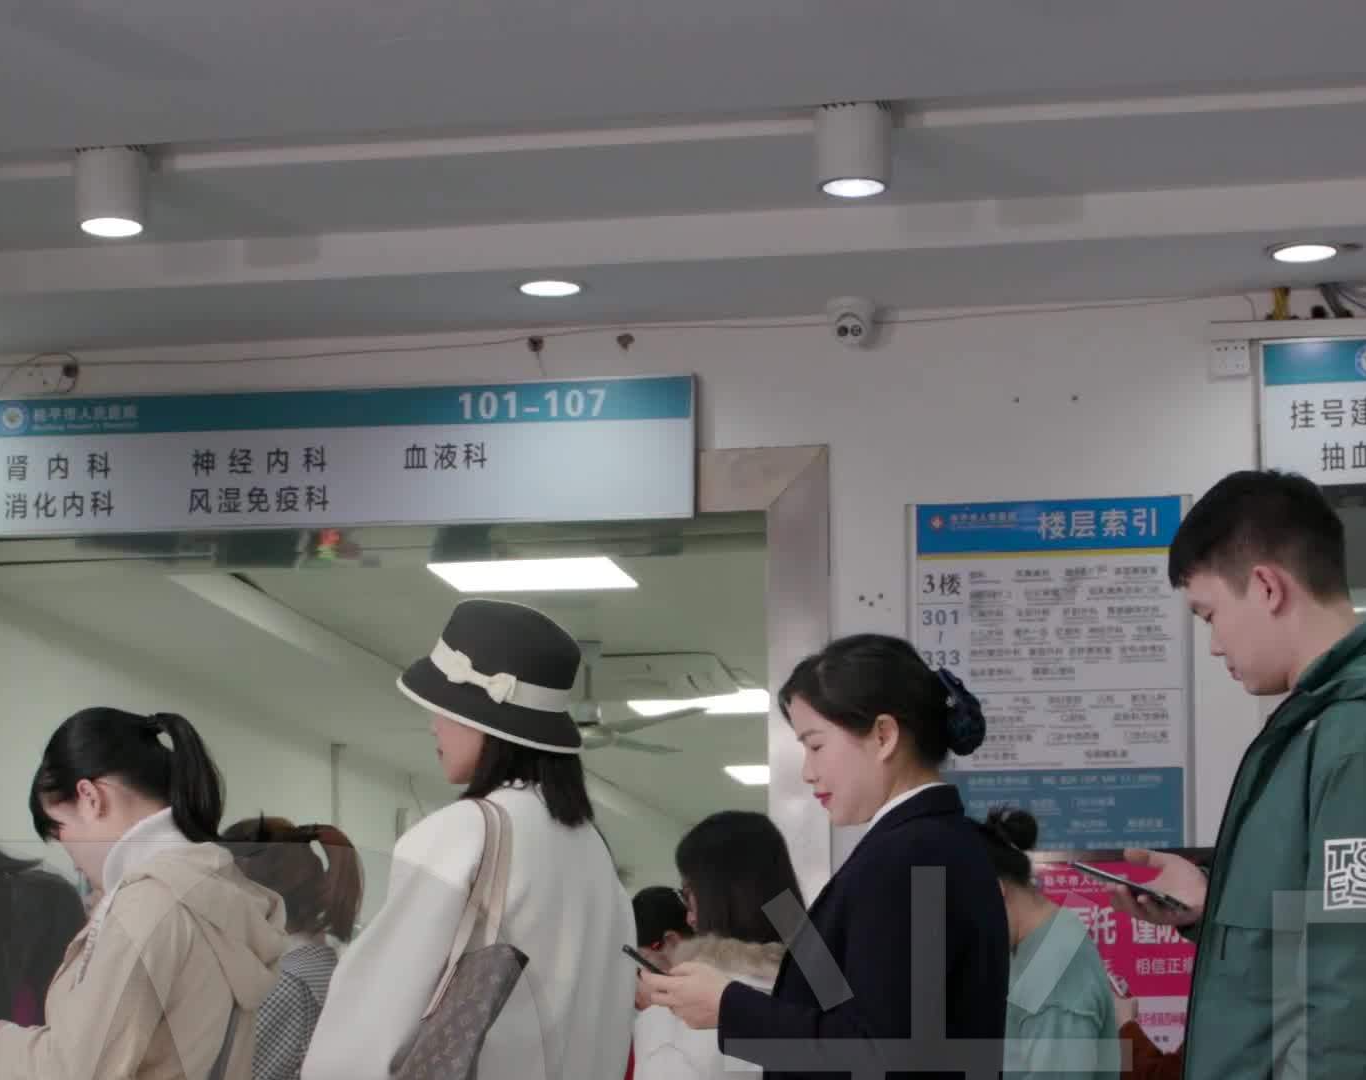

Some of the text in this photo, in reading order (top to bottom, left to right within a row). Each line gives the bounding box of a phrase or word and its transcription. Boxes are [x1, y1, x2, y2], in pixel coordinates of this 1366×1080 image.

[458, 388, 606, 420] 101-107
[6, 442, 487, 481] 肾内科 神经内科 血液科
[4, 485, 329, 520] 消化内科 风湿免疫科
[1037, 507, 1158, 540] 楼层索引
[922, 610, 961, 627] 301
